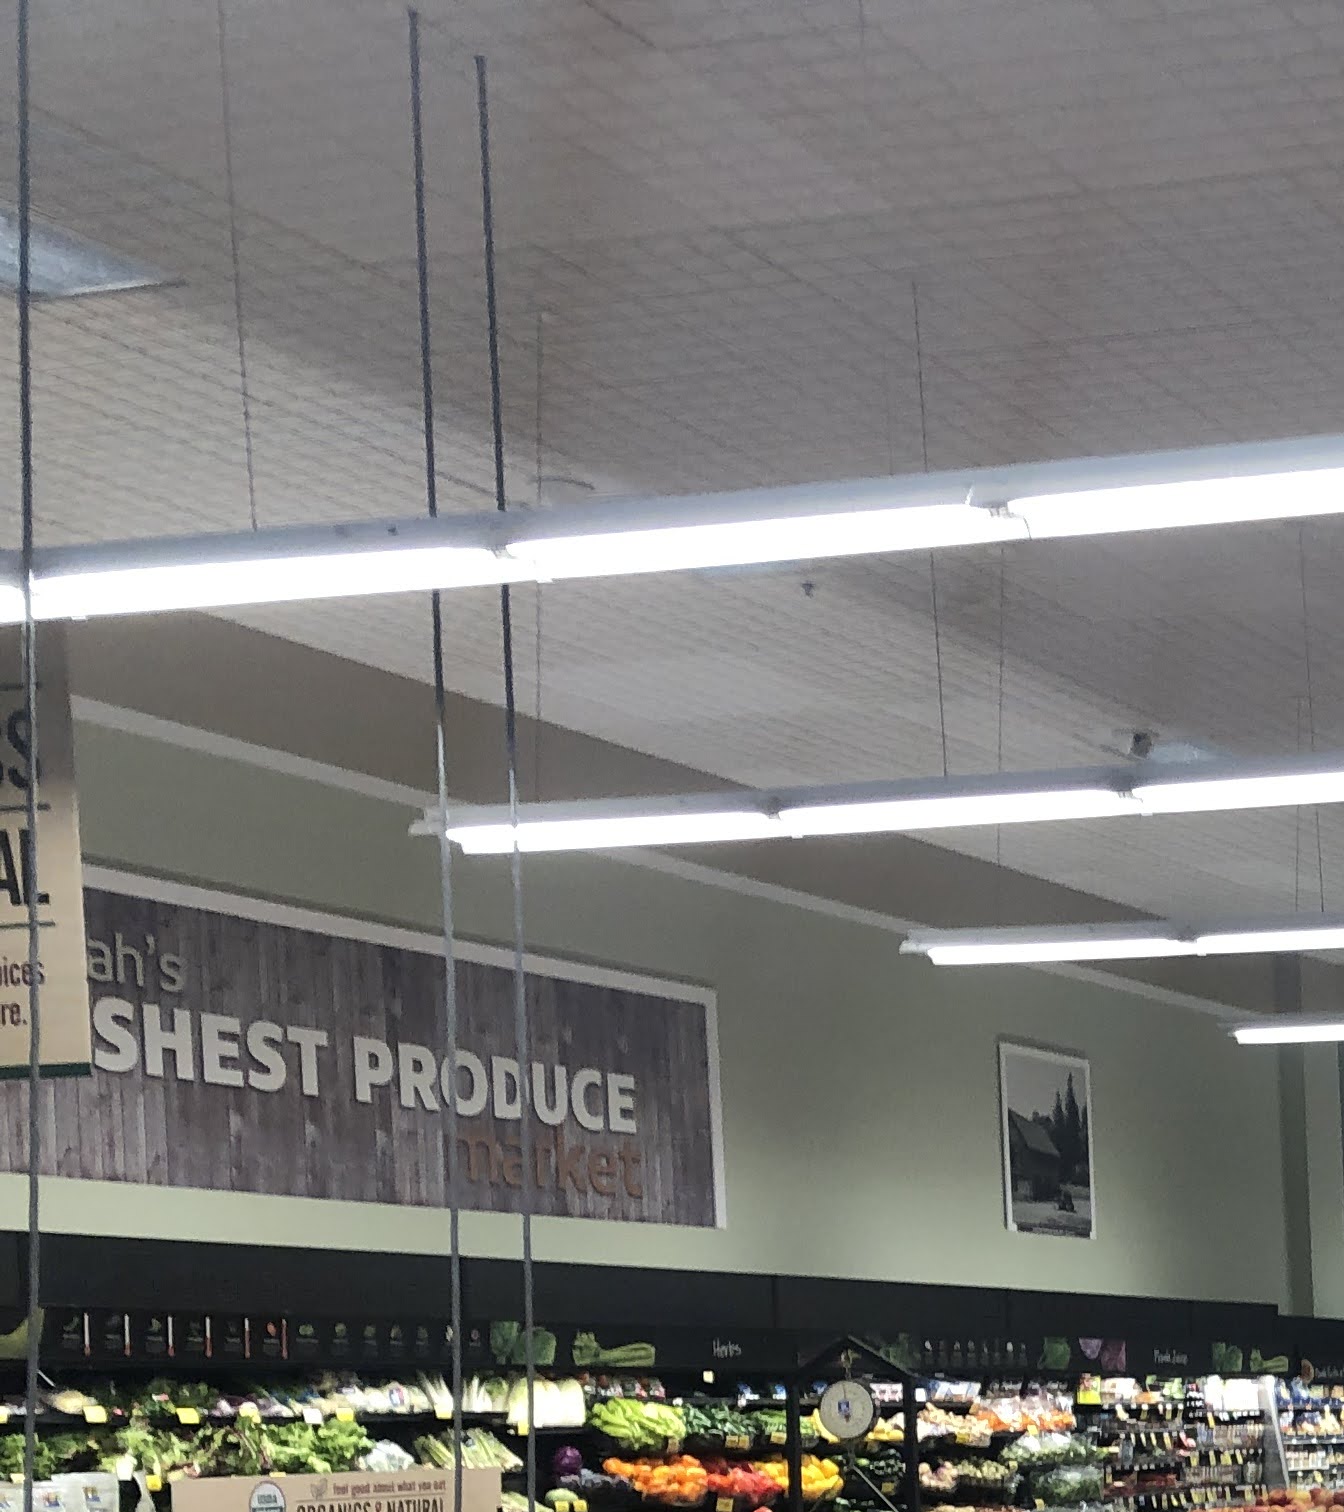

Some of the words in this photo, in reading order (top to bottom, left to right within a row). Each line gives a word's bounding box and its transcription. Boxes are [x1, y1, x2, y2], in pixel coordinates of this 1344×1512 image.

[92, 995, 328, 1098] SHEST
[353, 1035, 638, 1134] PRODUCE
[333, 1482, 350, 1495] feel
[351, 1482, 371, 1497] good
[398, 1480, 416, 1492] what
[418, 1481, 432, 1493] you
